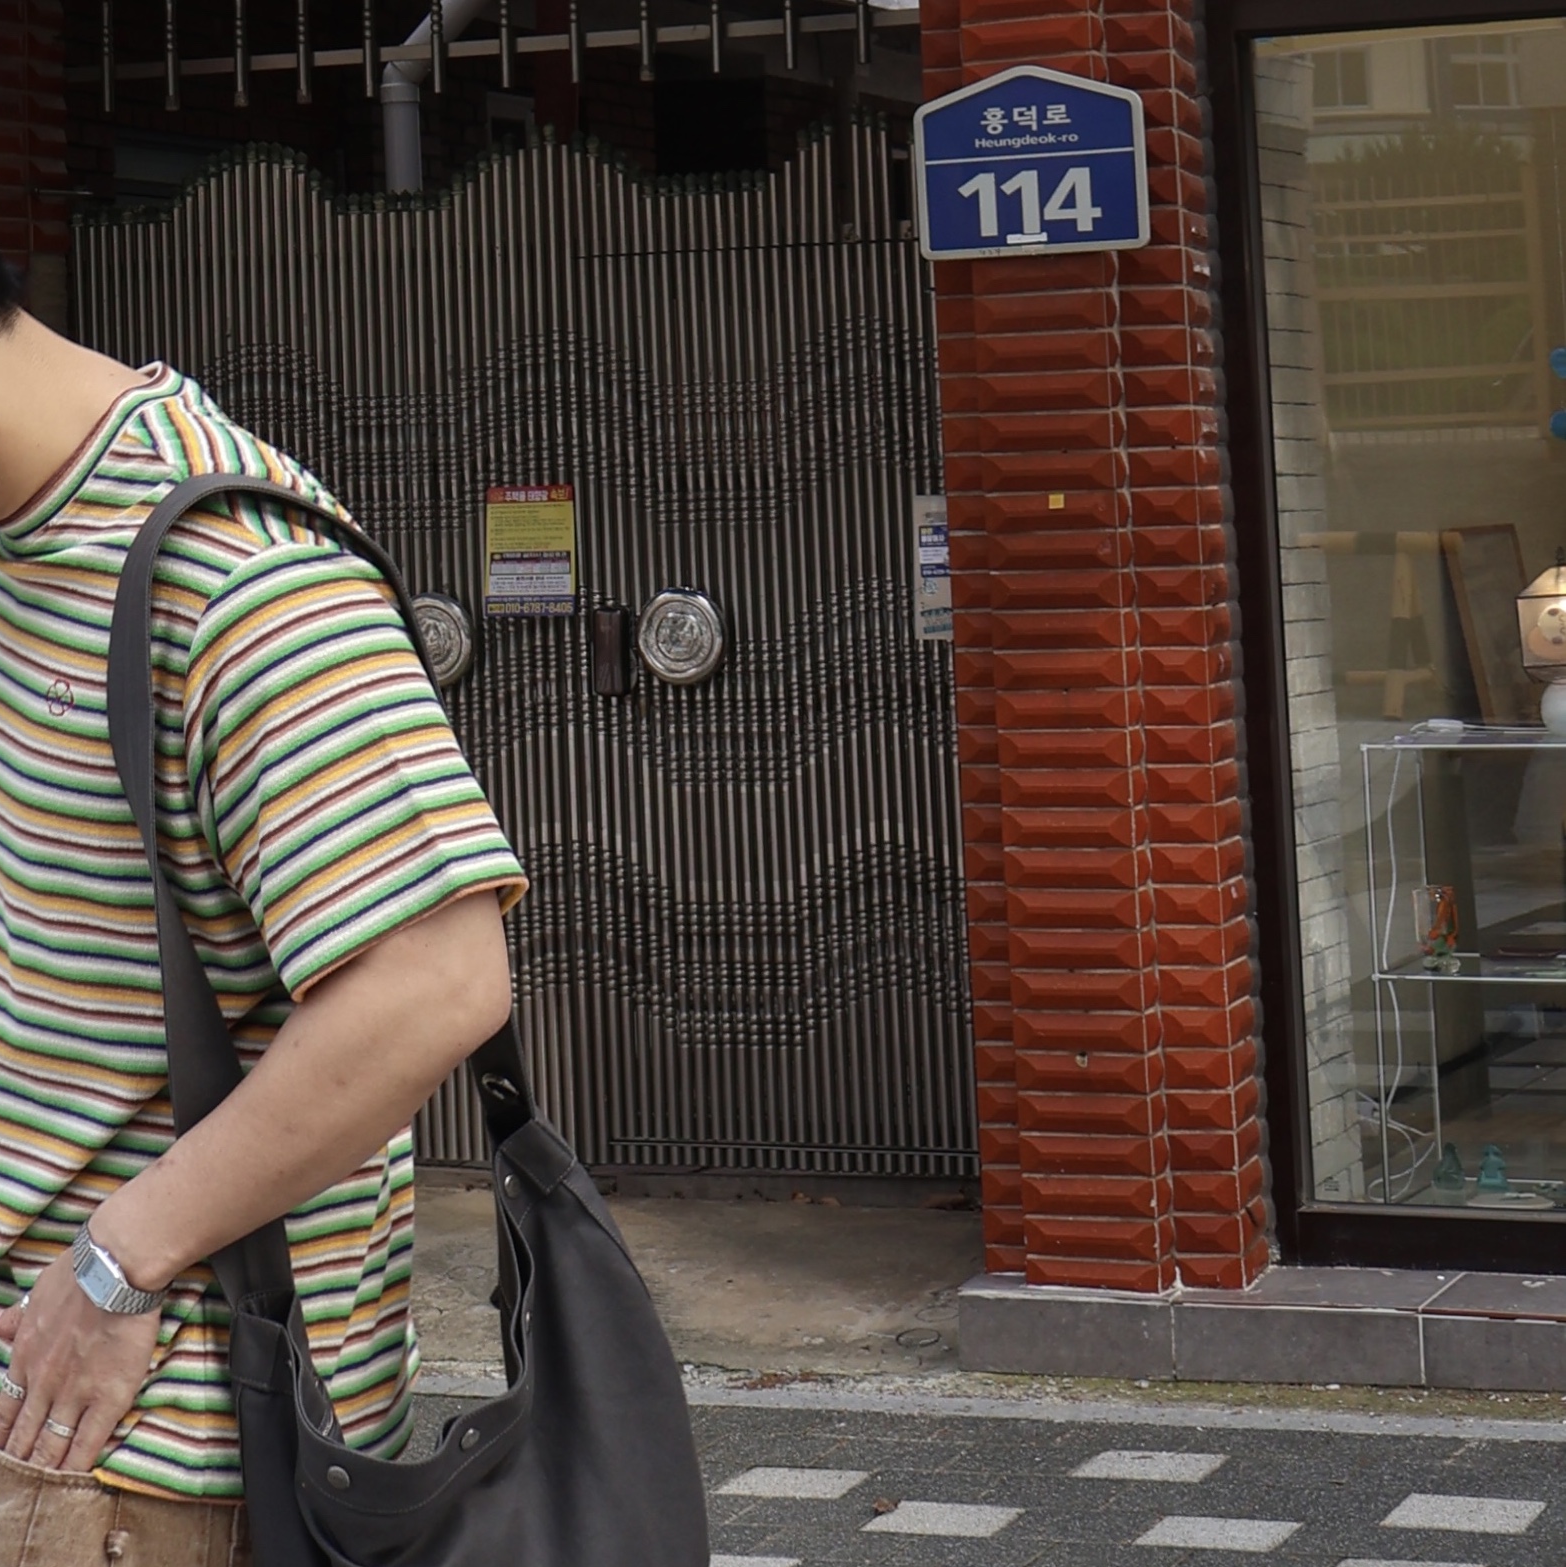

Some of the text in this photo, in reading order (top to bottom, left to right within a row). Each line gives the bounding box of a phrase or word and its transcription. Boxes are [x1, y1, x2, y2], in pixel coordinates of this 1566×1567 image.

[980, 104, 1071, 135] 흥덕로
[975, 133, 1079, 148] Heungdeok-ro
[957, 167, 1102, 237] 114
